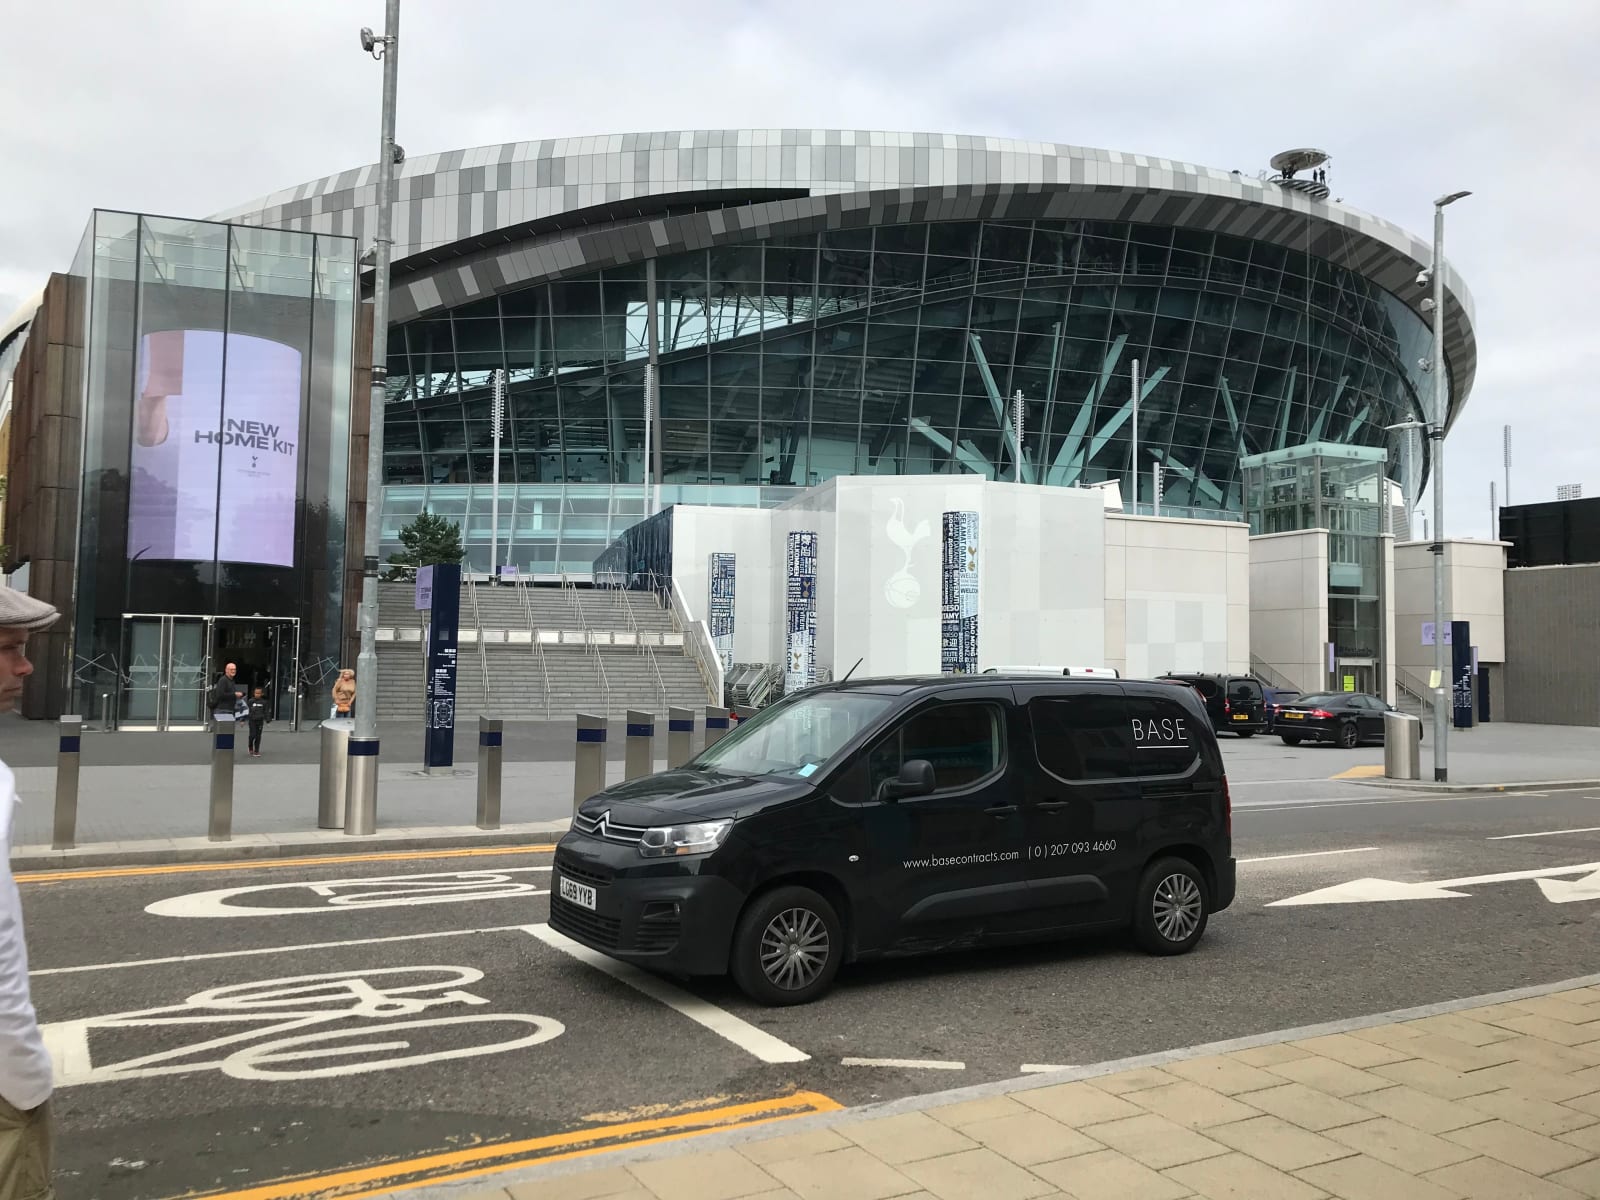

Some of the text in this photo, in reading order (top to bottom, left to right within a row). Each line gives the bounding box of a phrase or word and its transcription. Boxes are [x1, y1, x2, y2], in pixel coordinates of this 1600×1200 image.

[228, 419, 279, 438] NEW
[195, 430, 294, 456] HOME KIT
[1132, 718, 1188, 740] BASE
[902, 851, 1019, 869] www.basecontracts.com
[1051, 844, 1069, 856] 207
[1072, 842, 1090, 854] 093
[1092, 840, 1116, 852] 4660
[579, 886, 592, 905] YYB
